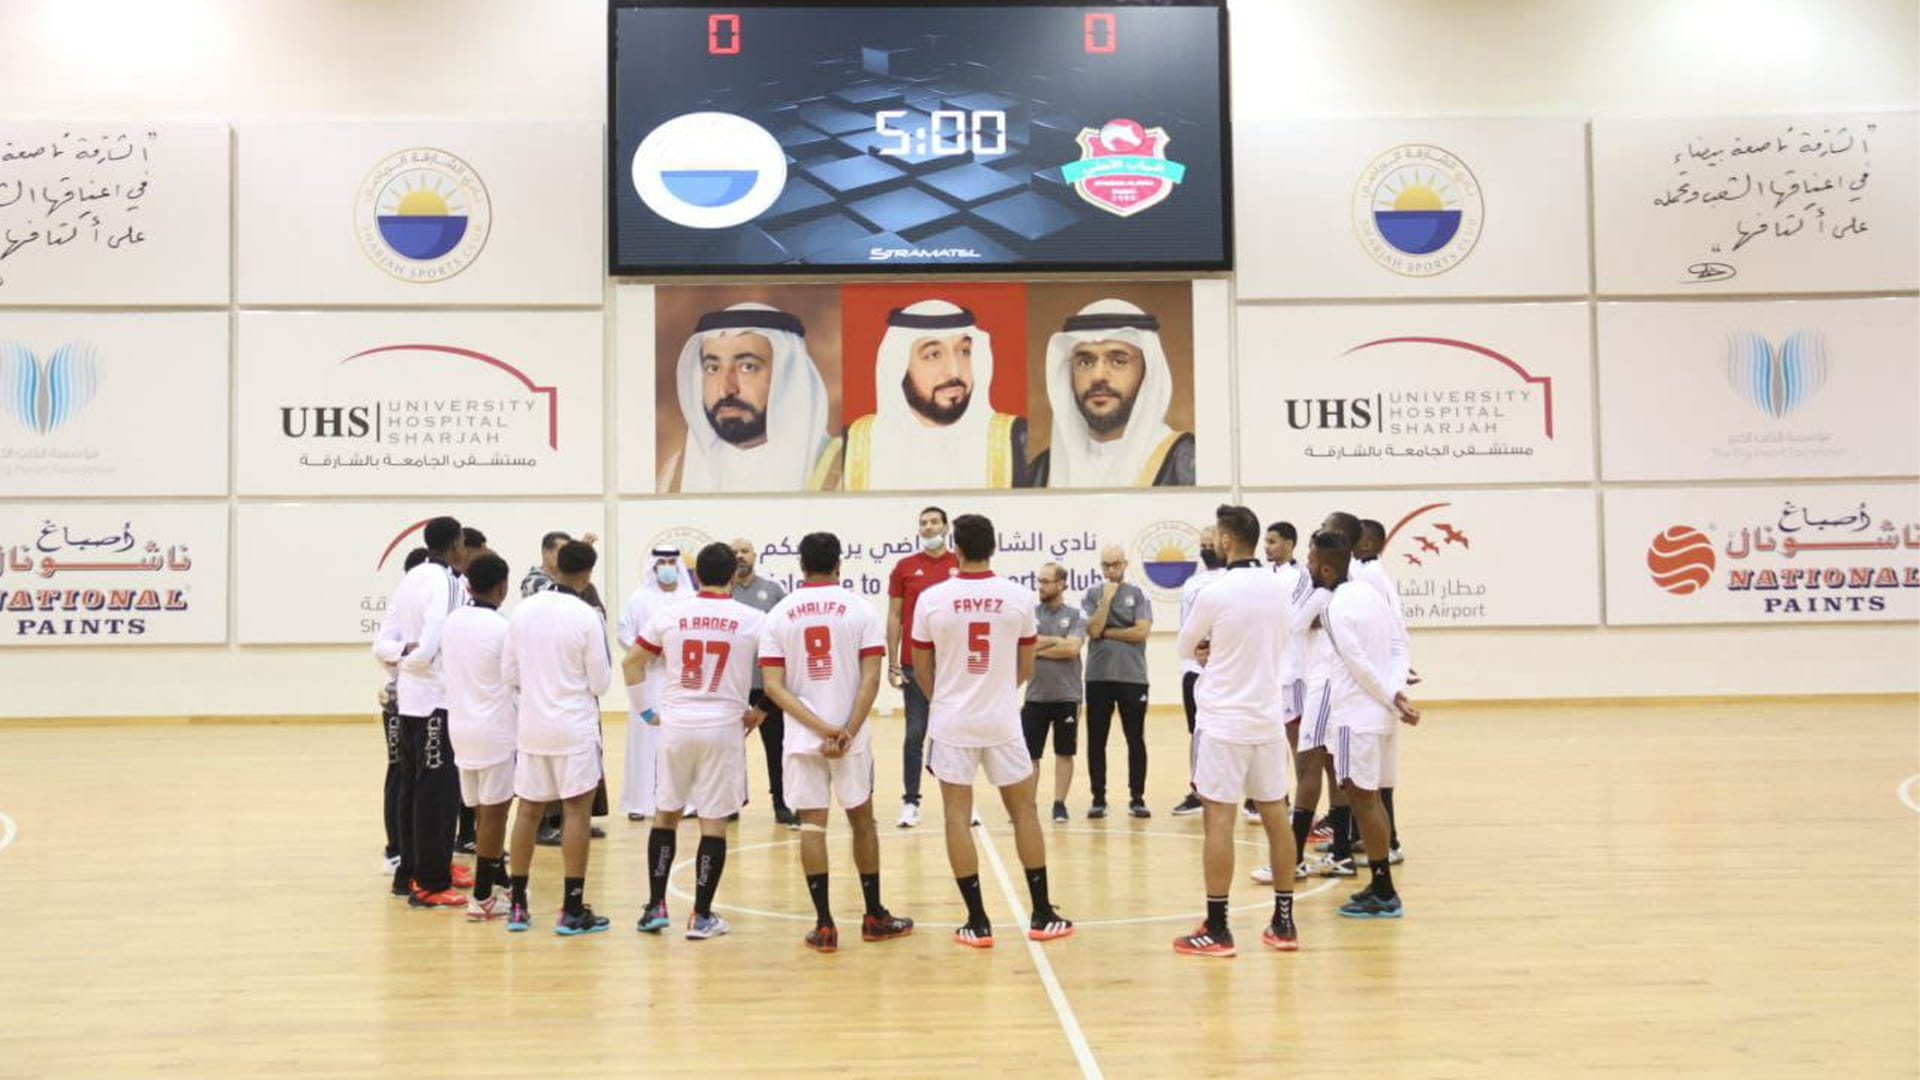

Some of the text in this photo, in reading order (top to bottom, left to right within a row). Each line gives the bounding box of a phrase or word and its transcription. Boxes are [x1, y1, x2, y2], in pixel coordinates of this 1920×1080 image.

[709, 14, 740, 54] 0
[1085, 13, 1116, 53] 0
[876, 110, 1006, 155] 5:00
[869, 247, 982, 260] STRAMATEL
[388, 400, 536, 412] UNIVERSITY
[1389, 390, 1531, 402] UNIVERSITY
[280, 406, 370, 438] UHS
[388, 416, 508, 428] HOSPITAL
[1284, 397, 1371, 430] UHS
[1390, 406, 1504, 418] HOSPITAL
[388, 432, 500, 444] SHARJAH
[1390, 422, 1497, 434] SHARJAH
[299, 453, 537, 469] مستشفى الجامعة بالشارقة
[1305, 445, 1534, 460] مستشفى الجامعة بالشارقة
[1778, 501, 1871, 533] أصباغ
[36, 519, 135, 552] أصباغ
[998, 531, 1043, 551] الشا
[1051, 532, 1097, 560] نادي
[0, 541, 192, 579] ناشونا
[1728, 566, 1920, 591] NATIONAL
[1397, 578, 1486, 600] مطار الشا
[787, 601, 846, 621] KHALIFA
[953, 598, 1003, 613] FAYEZ
[1429, 604, 1487, 619] Airport
[1764, 595, 1886, 613] PAINTS
[17, 619, 146, 635] PAINTS
[804, 625, 833, 681] 8
[967, 621, 990, 675] 5
[680, 639, 731, 692] 87
